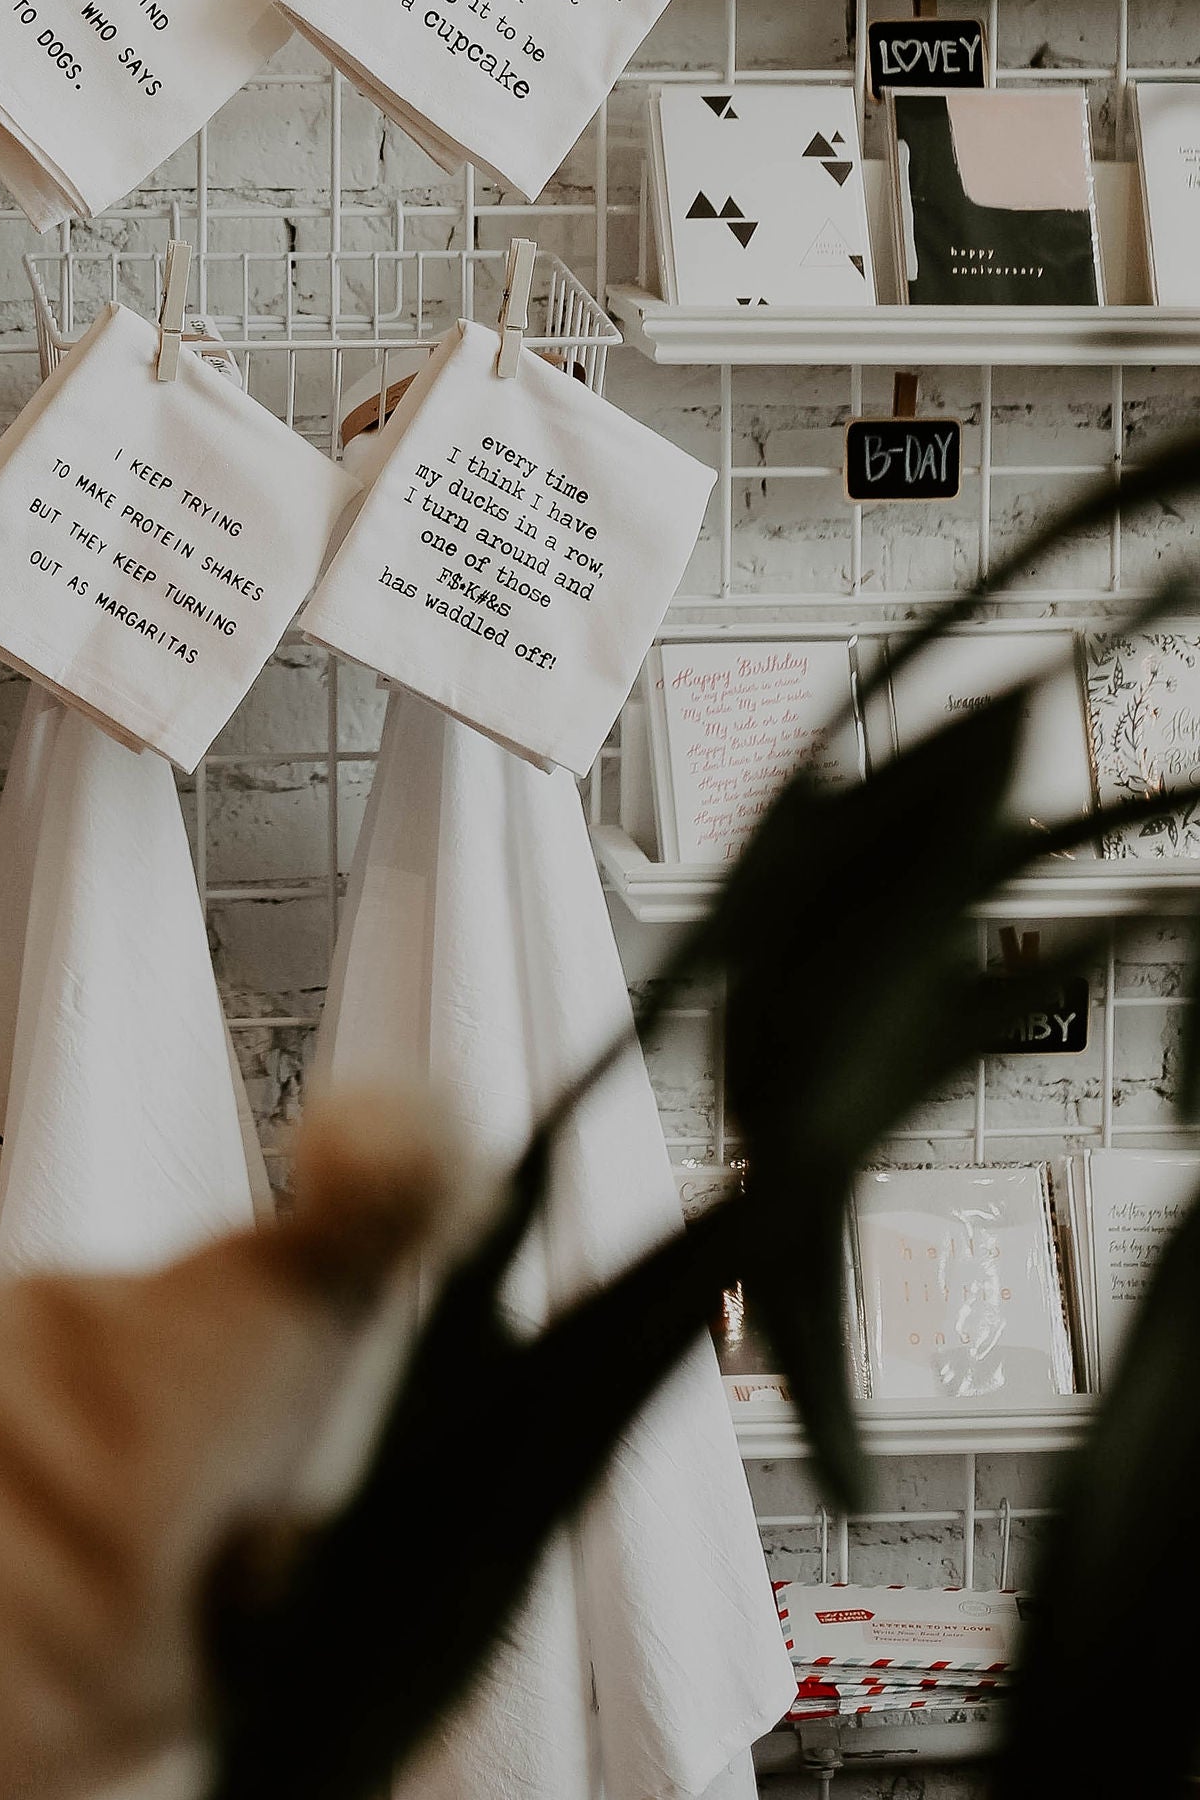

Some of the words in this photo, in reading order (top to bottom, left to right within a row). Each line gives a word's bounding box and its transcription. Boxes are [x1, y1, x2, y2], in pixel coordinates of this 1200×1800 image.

[36, 28, 83, 91] DOGS.
[80, 1, 118, 42] WHO
[117, 47, 163, 97] SAYS
[423, 10, 530, 100] cupcake
[495, 15, 517, 41] to
[521, 34, 545, 63] be
[950, 246, 995, 260] happy
[952, 264, 1044, 279] anniversary
[114, 448, 124, 461] I
[129, 458, 173, 490] KEEP
[180, 489, 243, 537] TRYING
[481, 436, 539, 479] every
[544, 468, 589, 505] time
[51, 458, 71, 479] TO
[74, 474, 117, 510] MAKE
[120, 504, 196, 559] PROTEIN
[200, 556, 265, 602] SHAKES
[403, 486, 418, 504] I
[421, 493, 470, 534] turn
[475, 528, 551, 577] around
[553, 571, 595, 602] and
[414, 463, 444, 489] my
[448, 478, 510, 522] ducks
[513, 514, 538, 541] in
[544, 535, 558, 552] a
[563, 545, 605, 580] row,
[28, 497, 63, 524] BUT
[69, 521, 108, 555] THEY
[112, 551, 157, 584] KEEP
[164, 582, 238, 636] TURNING
[29, 550, 63, 577] OUT
[66, 575, 89, 596] AS
[94, 591, 199, 664] MARGARITAS
[420, 529, 458, 557] one
[463, 553, 492, 574] of
[495, 565, 552, 608] those
[377, 564, 419, 599] has
[424, 592, 510, 648] waddled
[514, 643, 557, 671] off!
[671, 666, 732, 693] Happy
[736, 651, 809, 676] Birthday
